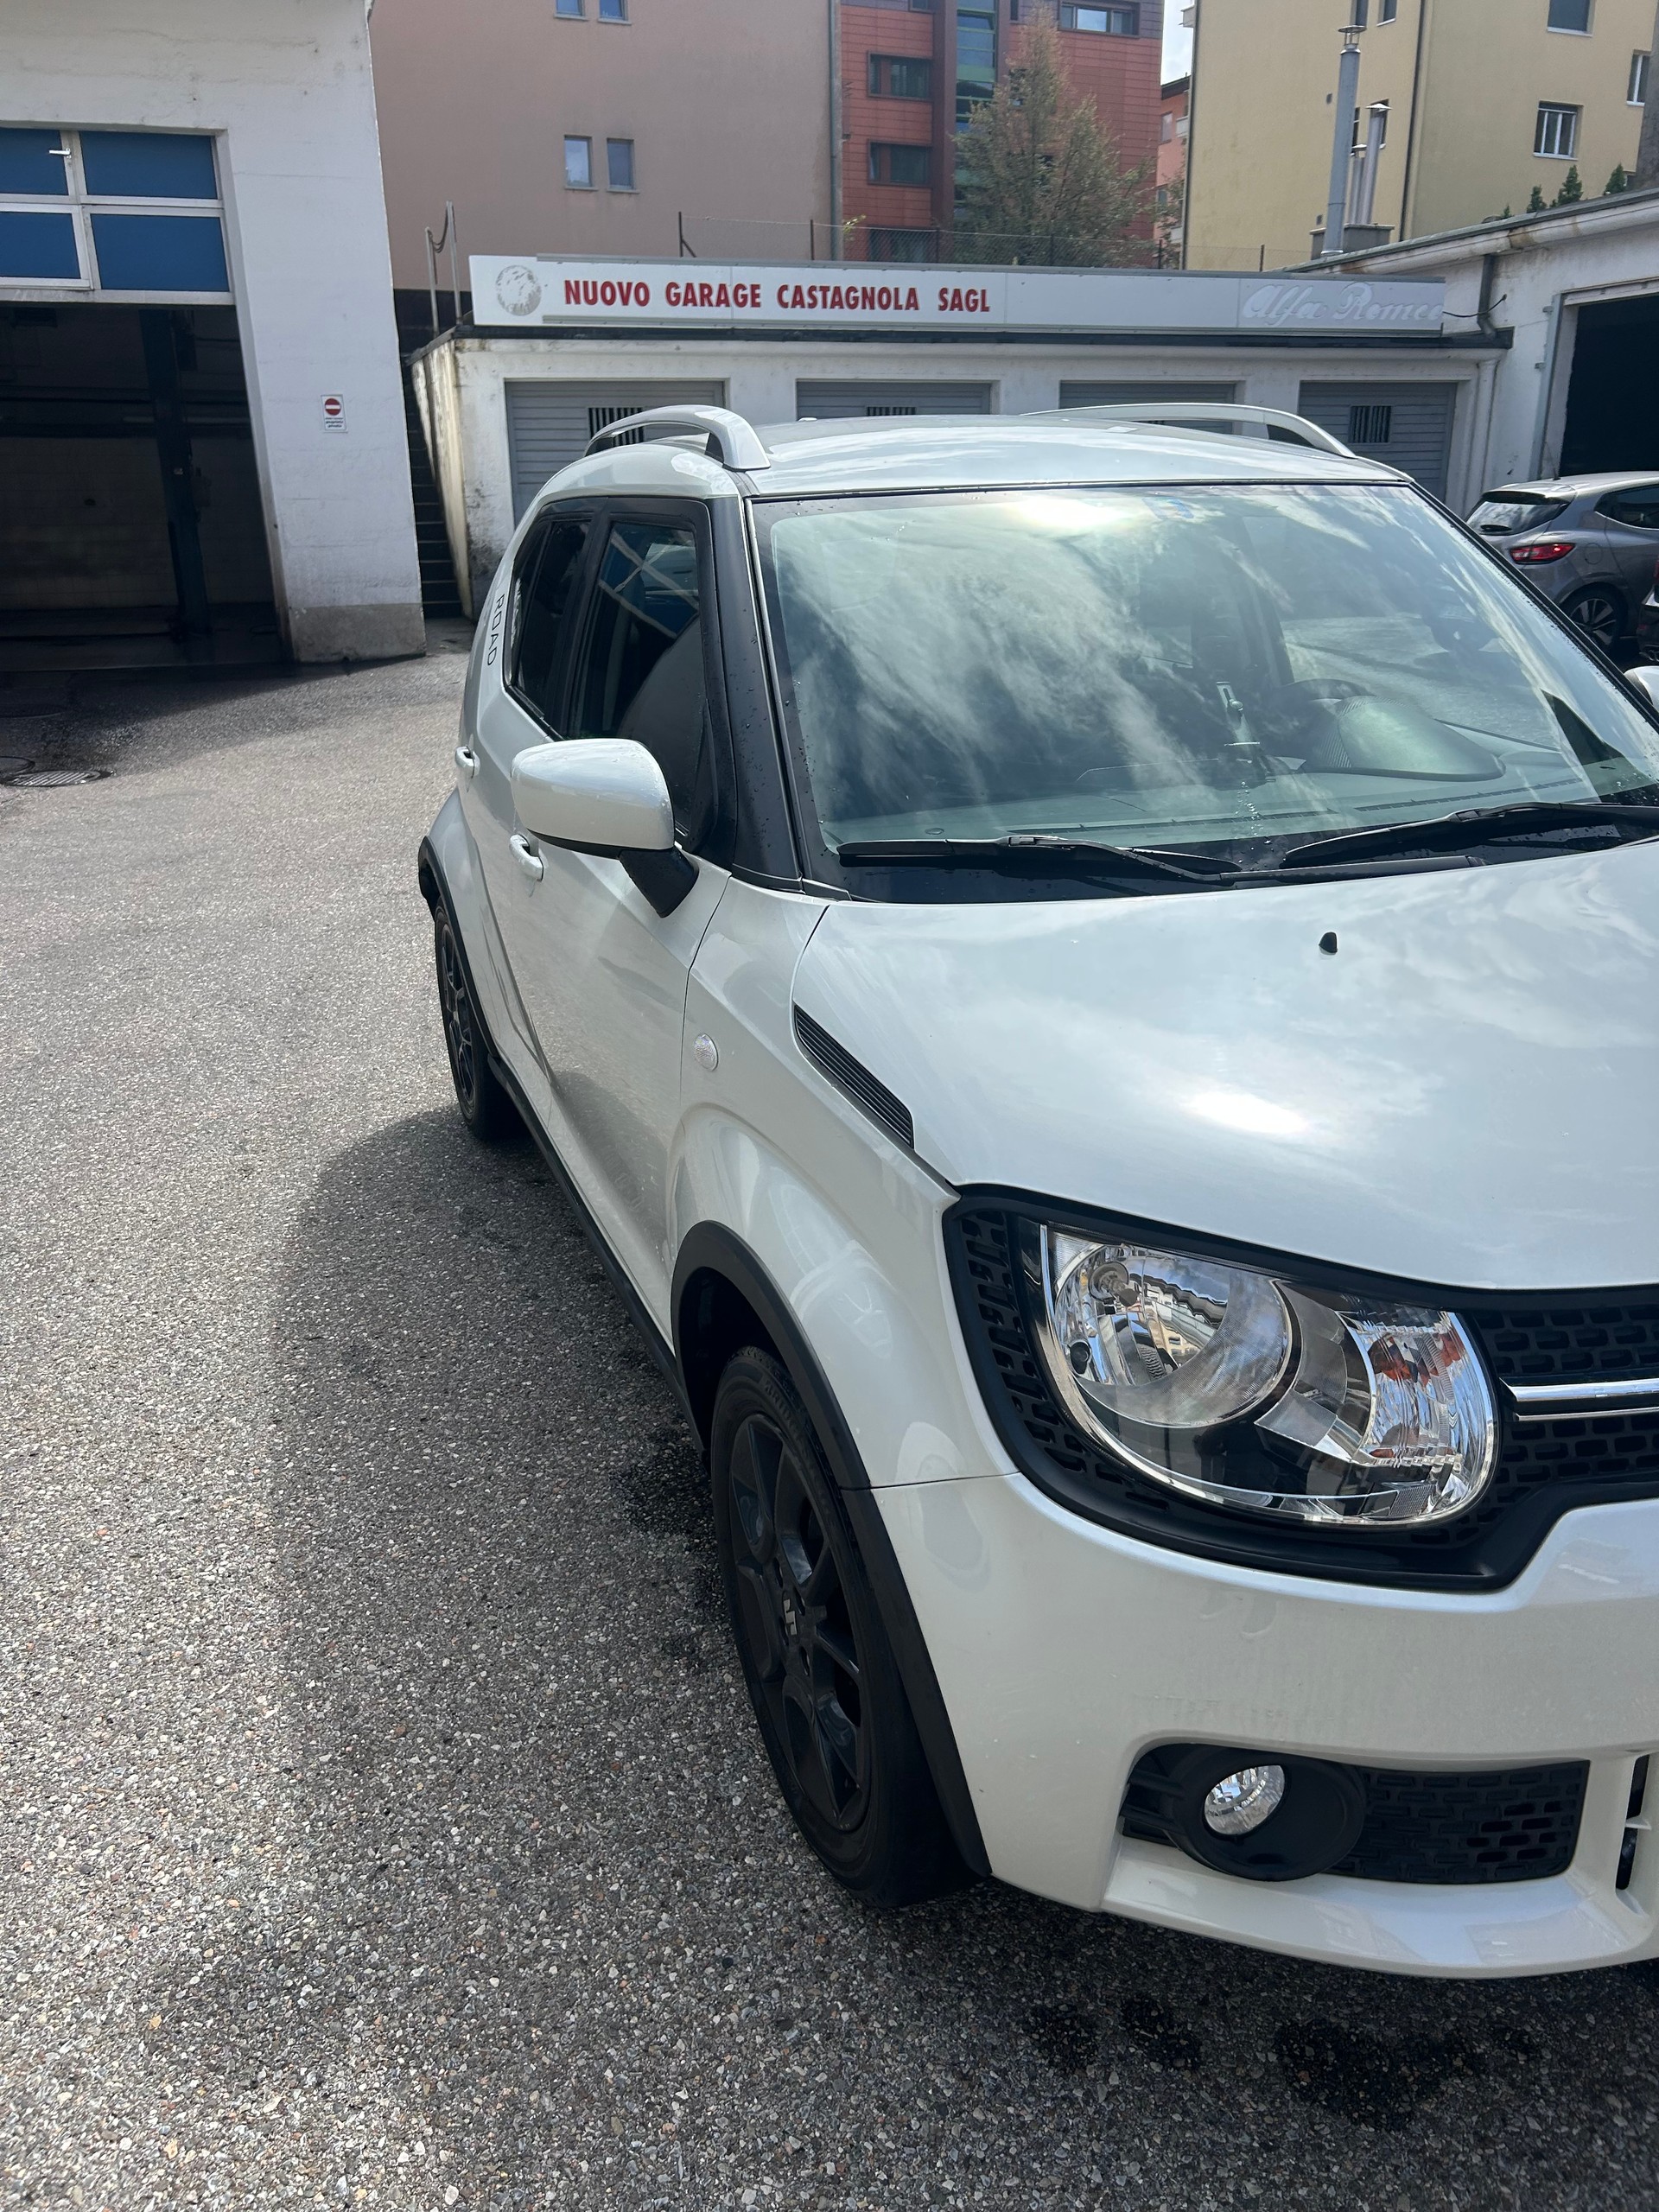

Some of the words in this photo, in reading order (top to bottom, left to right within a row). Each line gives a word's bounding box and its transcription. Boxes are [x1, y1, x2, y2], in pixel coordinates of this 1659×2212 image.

[564, 279, 650, 308] NUOVO
[665, 282, 760, 308] GARAGE
[778, 284, 919, 311] CASTAGNOLA
[938, 288, 989, 313] SAGL
[1243, 283, 1328, 327] Alfa
[1333, 281, 1443, 321] Romeo
[487, 594, 505, 666] ROAD
